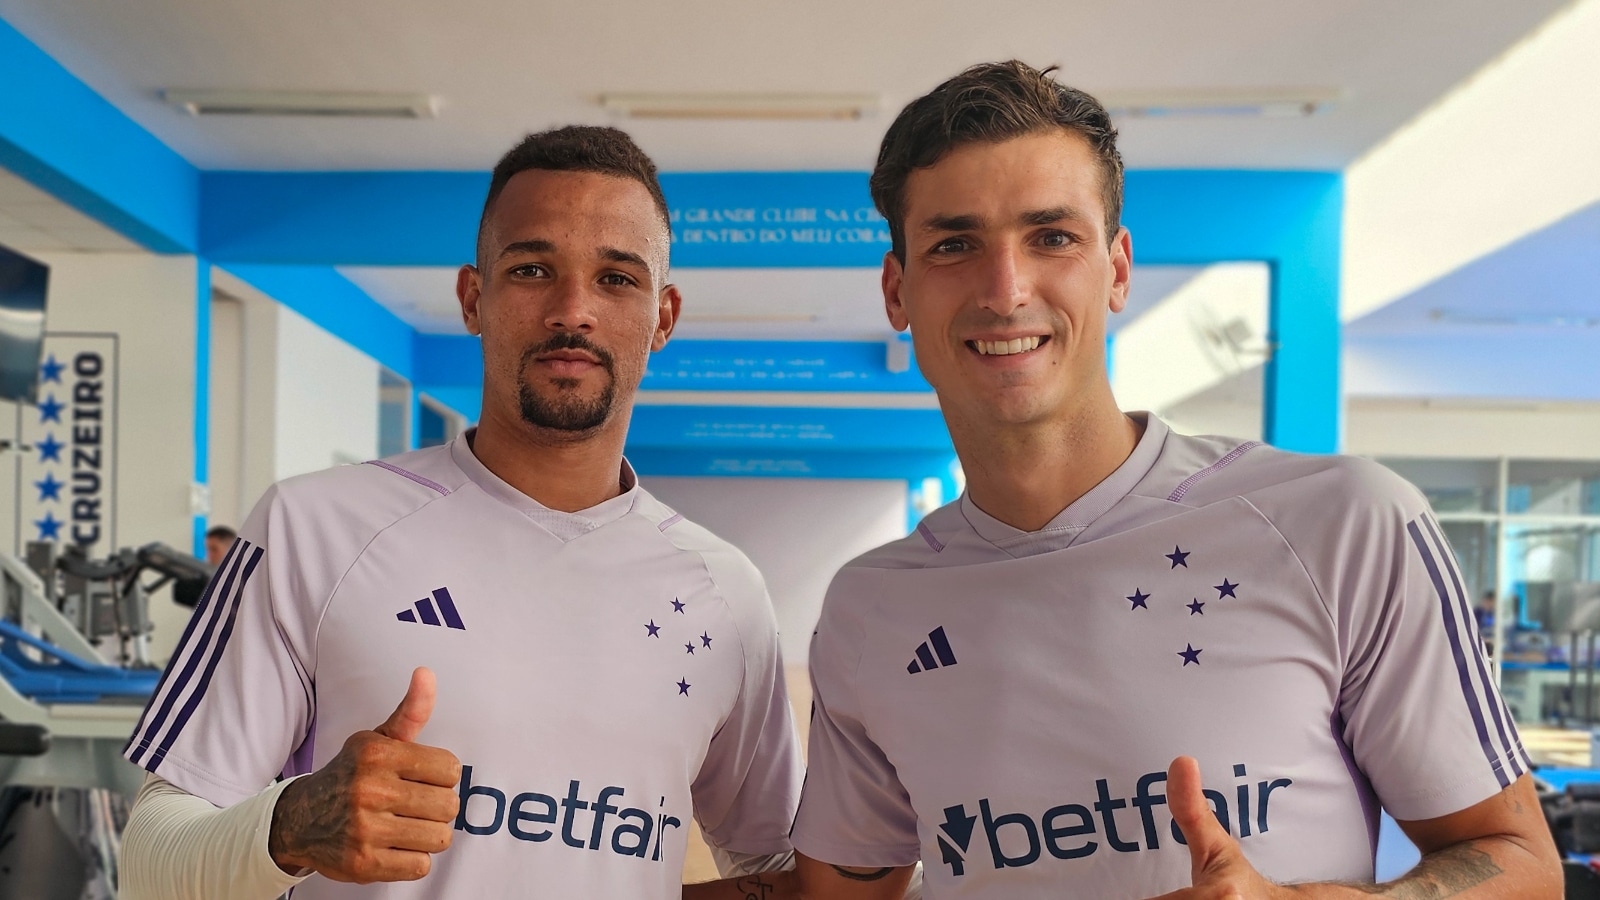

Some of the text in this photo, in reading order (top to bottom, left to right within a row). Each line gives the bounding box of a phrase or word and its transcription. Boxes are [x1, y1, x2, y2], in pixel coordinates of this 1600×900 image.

[683, 228, 755, 243] DENTRO
[759, 228, 787, 243] DO
[791, 228, 832, 243] MEU
[834, 227, 892, 243] CORA
[684, 207, 756, 223] GRANDE
[762, 207, 817, 223] CLUBE
[824, 208, 849, 222] NA
[71, 351, 103, 546] CRUZEIRO
[453, 764, 682, 862] betfair
